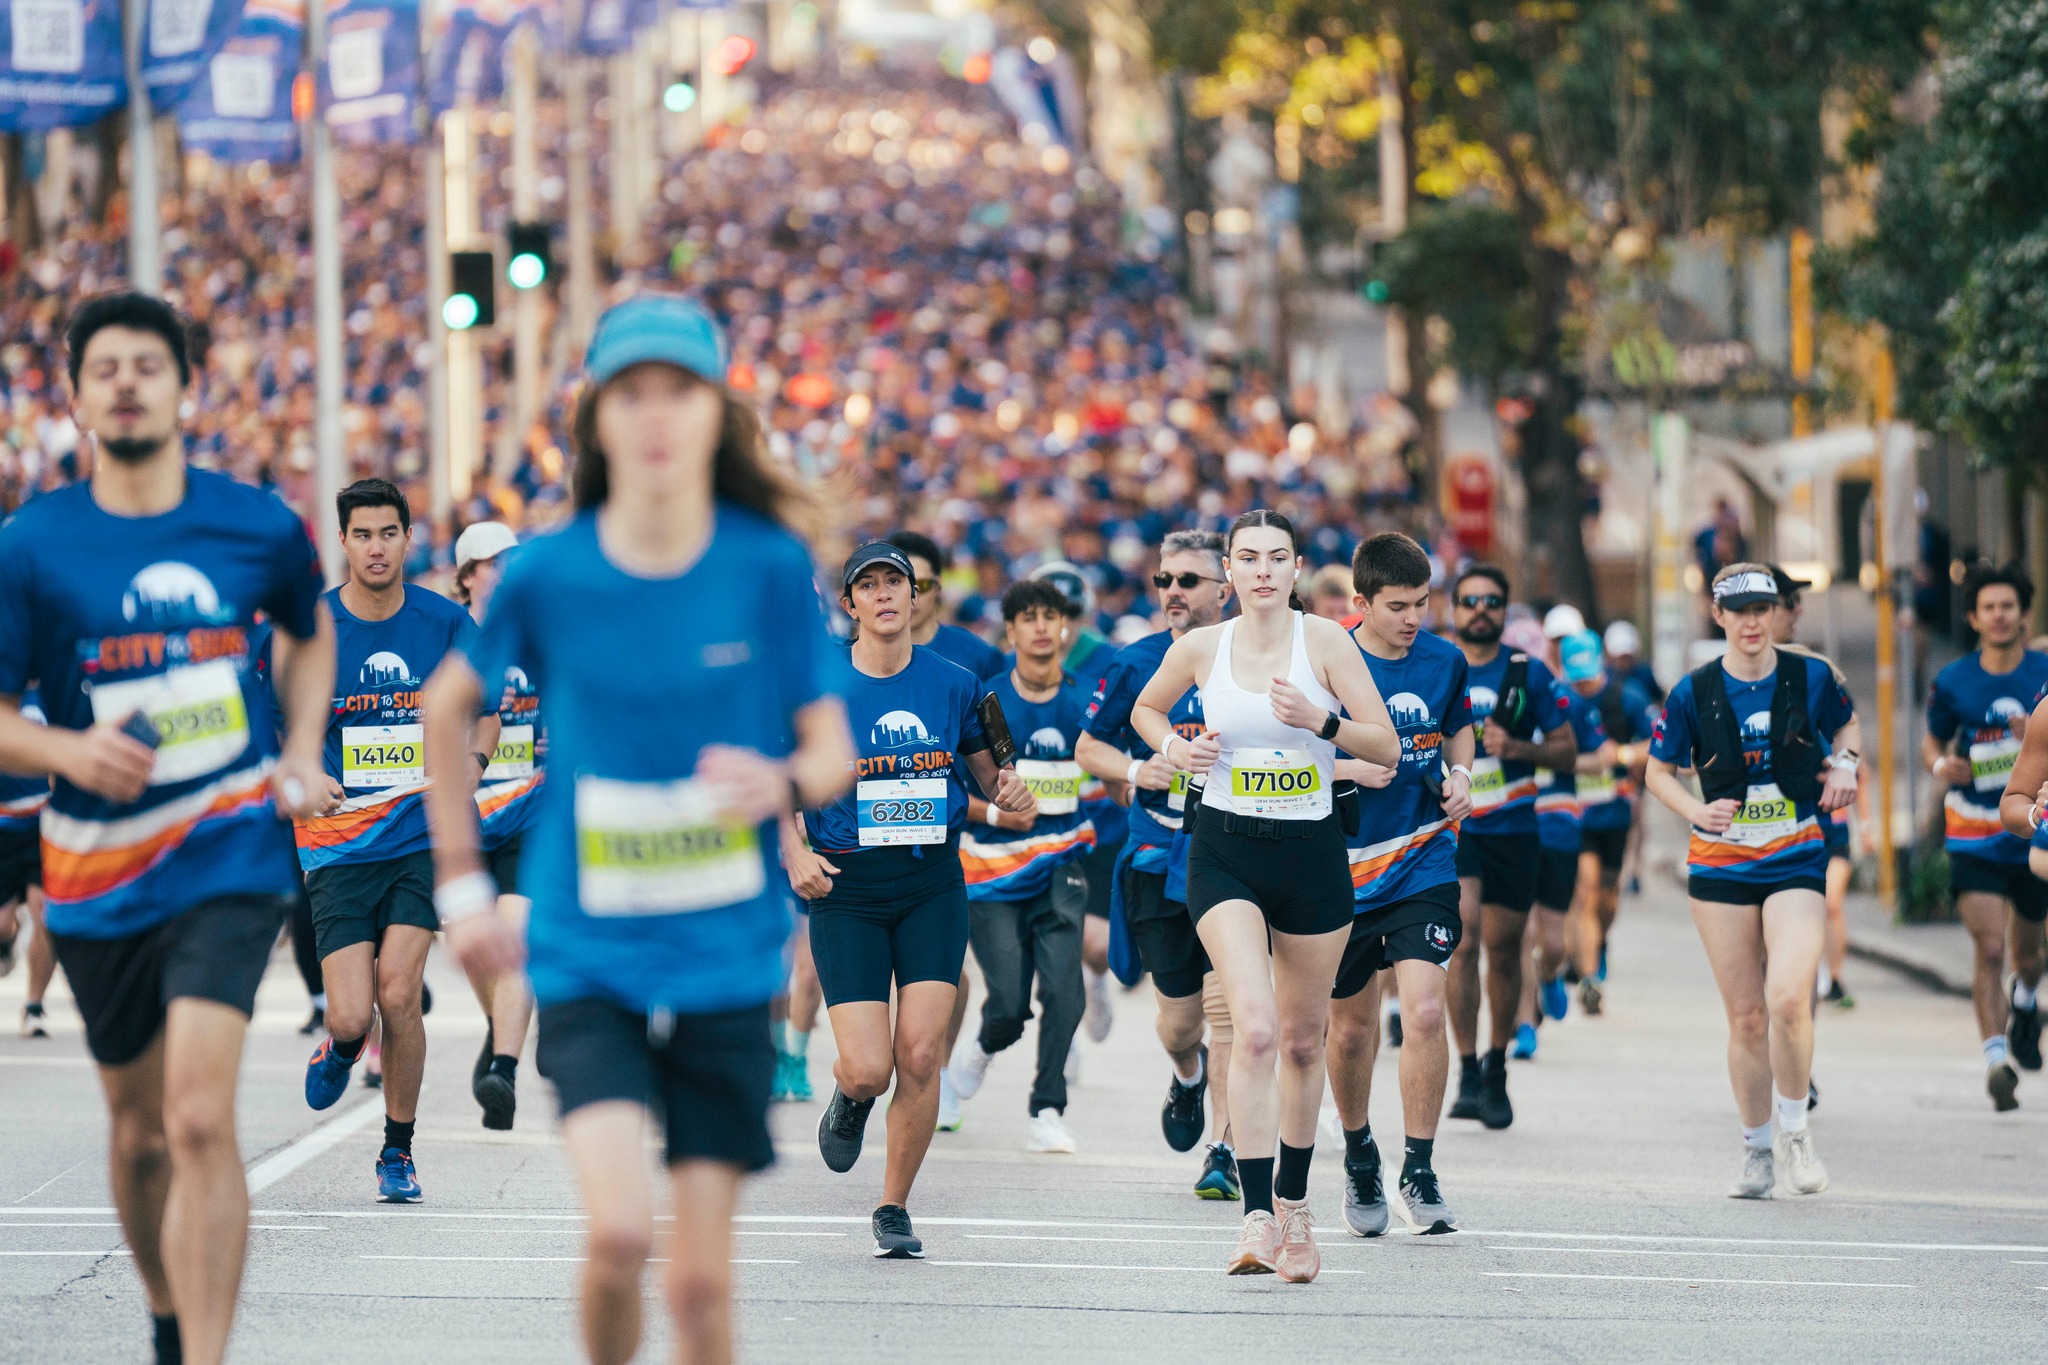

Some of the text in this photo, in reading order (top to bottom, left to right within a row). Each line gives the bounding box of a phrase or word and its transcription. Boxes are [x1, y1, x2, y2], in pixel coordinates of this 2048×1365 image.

[99, 632, 166, 672] CITY
[346, 694, 380, 711] CITY
[393, 691, 425, 709] SUR
[352, 746, 415, 766] 14140
[855, 754, 897, 777] CITY
[1402, 754, 1414, 762] FOR
[1025, 780, 1074, 795] 7082
[1241, 770, 1312, 792] 17100
[872, 802, 934, 822] 6282
[1732, 801, 1787, 820] 7892
